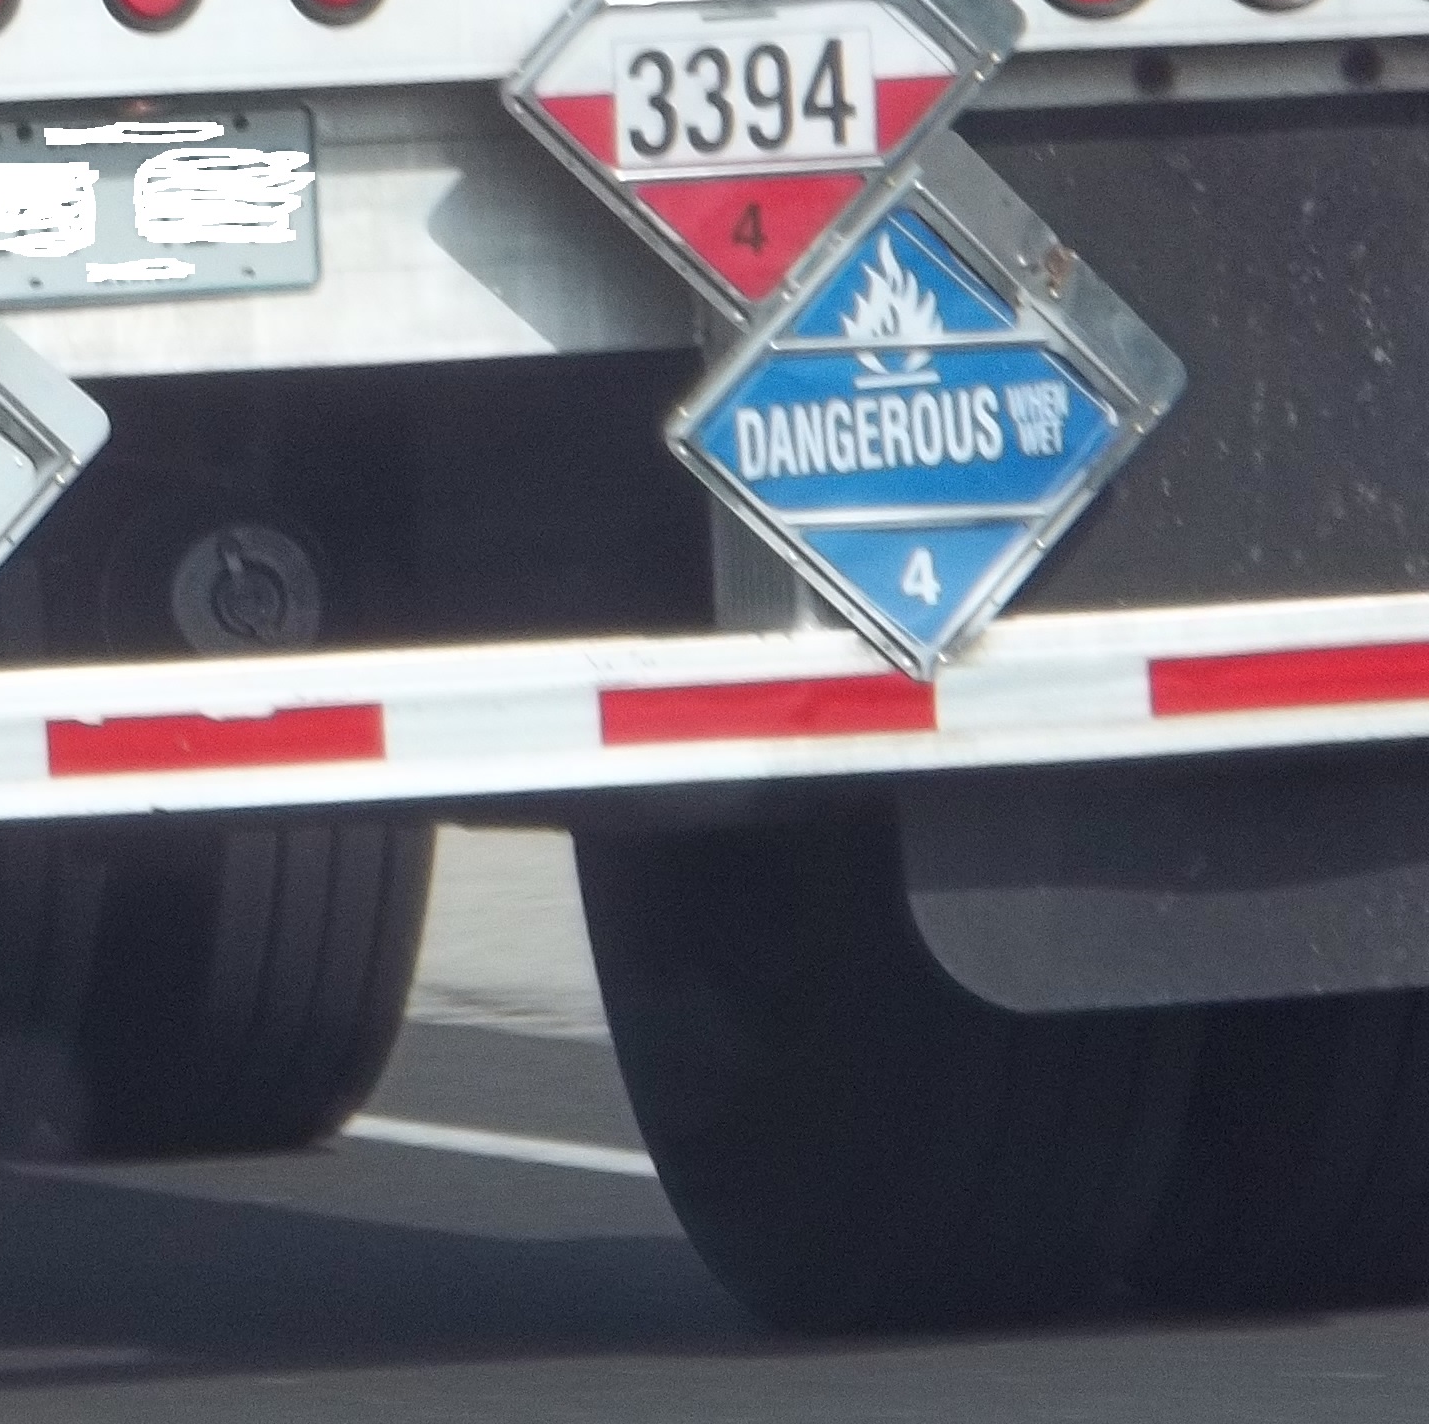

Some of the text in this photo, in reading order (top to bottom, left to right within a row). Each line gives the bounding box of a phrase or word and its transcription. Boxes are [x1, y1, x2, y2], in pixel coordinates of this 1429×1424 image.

[626, 38, 857, 158] 3394
[730, 201, 769, 255] 4
[735, 385, 1004, 481] DANGEROUS
[900, 546, 942, 606] 4
